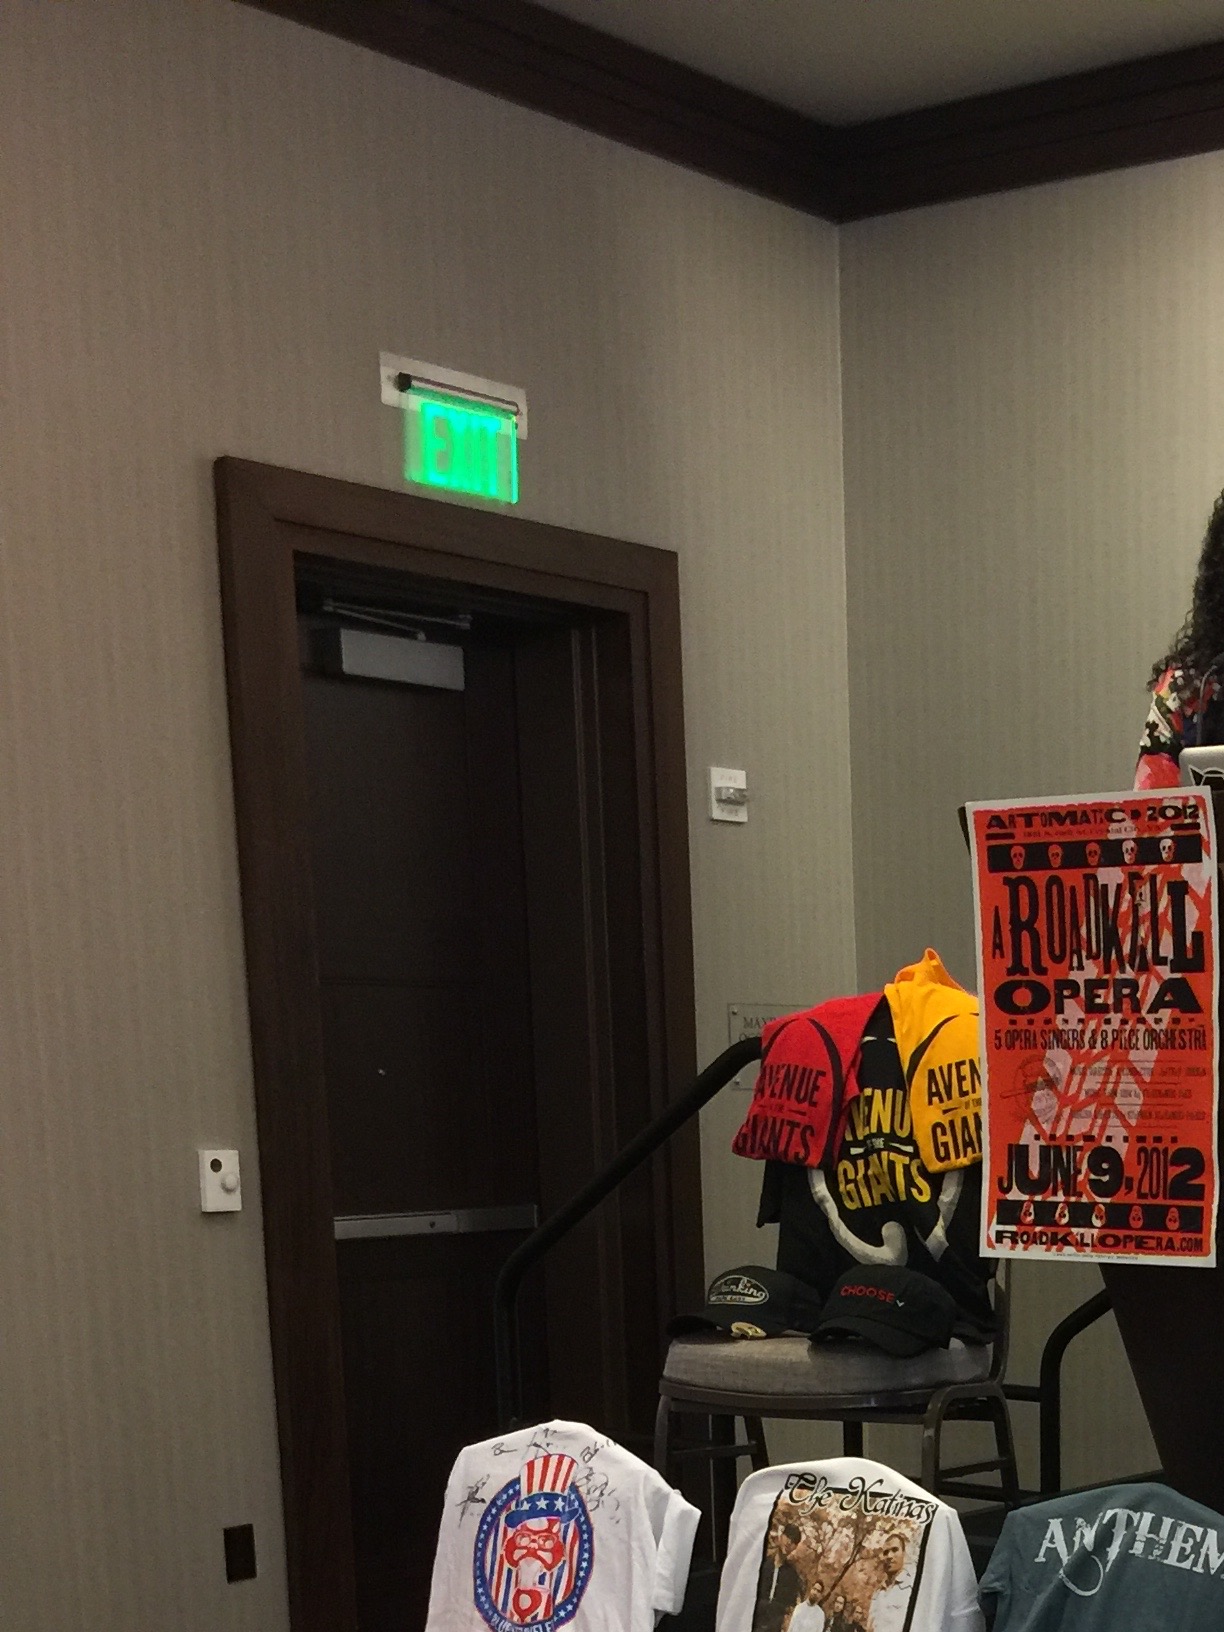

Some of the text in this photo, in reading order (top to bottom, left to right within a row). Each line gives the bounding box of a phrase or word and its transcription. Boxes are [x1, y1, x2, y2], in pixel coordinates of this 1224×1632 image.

[422, 403, 501, 497] EXIT
[1147, 805, 1200, 822] 2012
[992, 872, 1204, 976] A ROADKILL
[994, 977, 1204, 1015] OPERA
[995, 1027, 1207, 1051] 5 OPERA SINGERS & 8 PIECE ORCHESTRA
[755, 1063, 827, 1107] AVENUE
[927, 1057, 981, 1106] AVEN
[736, 1115, 816, 1162] GIANTS
[846, 1088, 912, 1141] AVENU
[931, 1111, 982, 1163] GIAN
[838, 1151, 932, 1210] GIANTS
[997, 1144, 1083, 1198] JUNE
[1137, 1146, 1205, 1200] 2012
[995, 1230, 1203, 1253] ROADKILLOPERA.COM
[840, 1285, 895, 1304] CHOOSE
[784, 1473, 938, 1525] The Katinas
